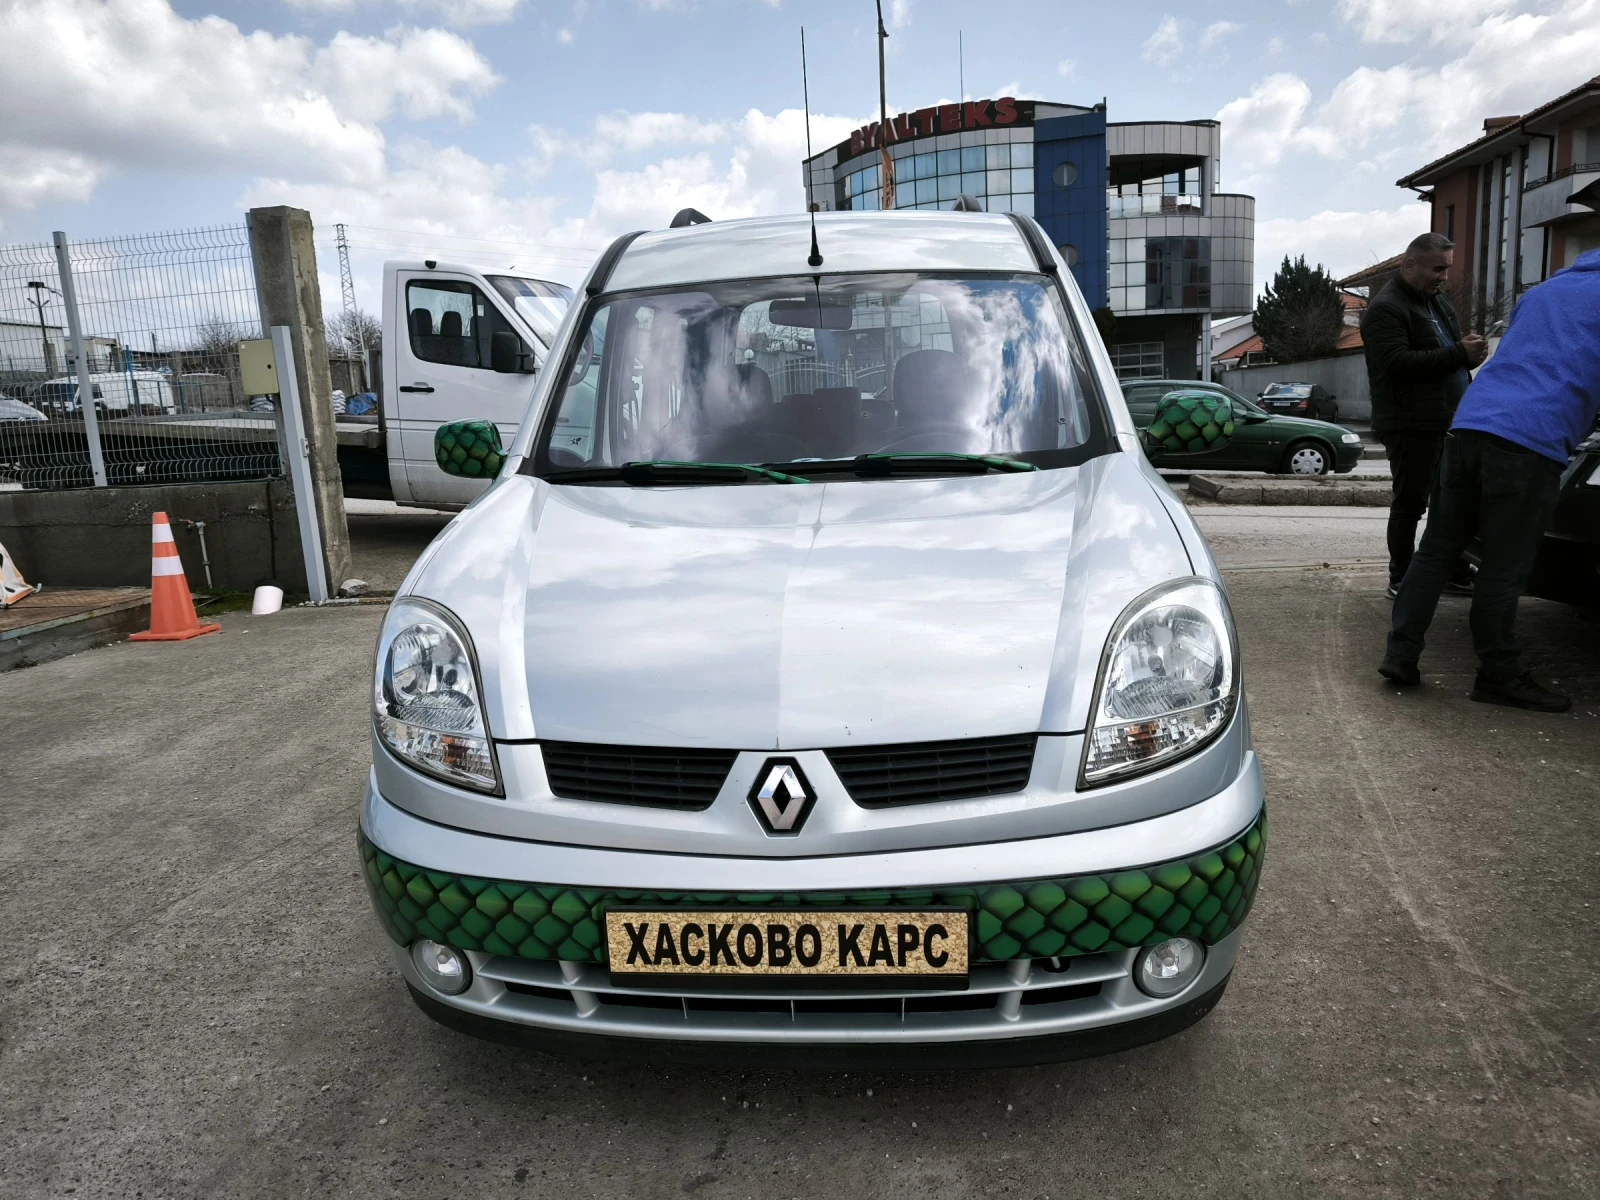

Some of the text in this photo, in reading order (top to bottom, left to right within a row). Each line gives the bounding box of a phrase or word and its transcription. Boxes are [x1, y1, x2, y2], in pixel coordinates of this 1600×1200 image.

[850, 97, 1018, 156] BYALTEKS
[623, 922, 949, 968] ХАСКОВО КАРС
